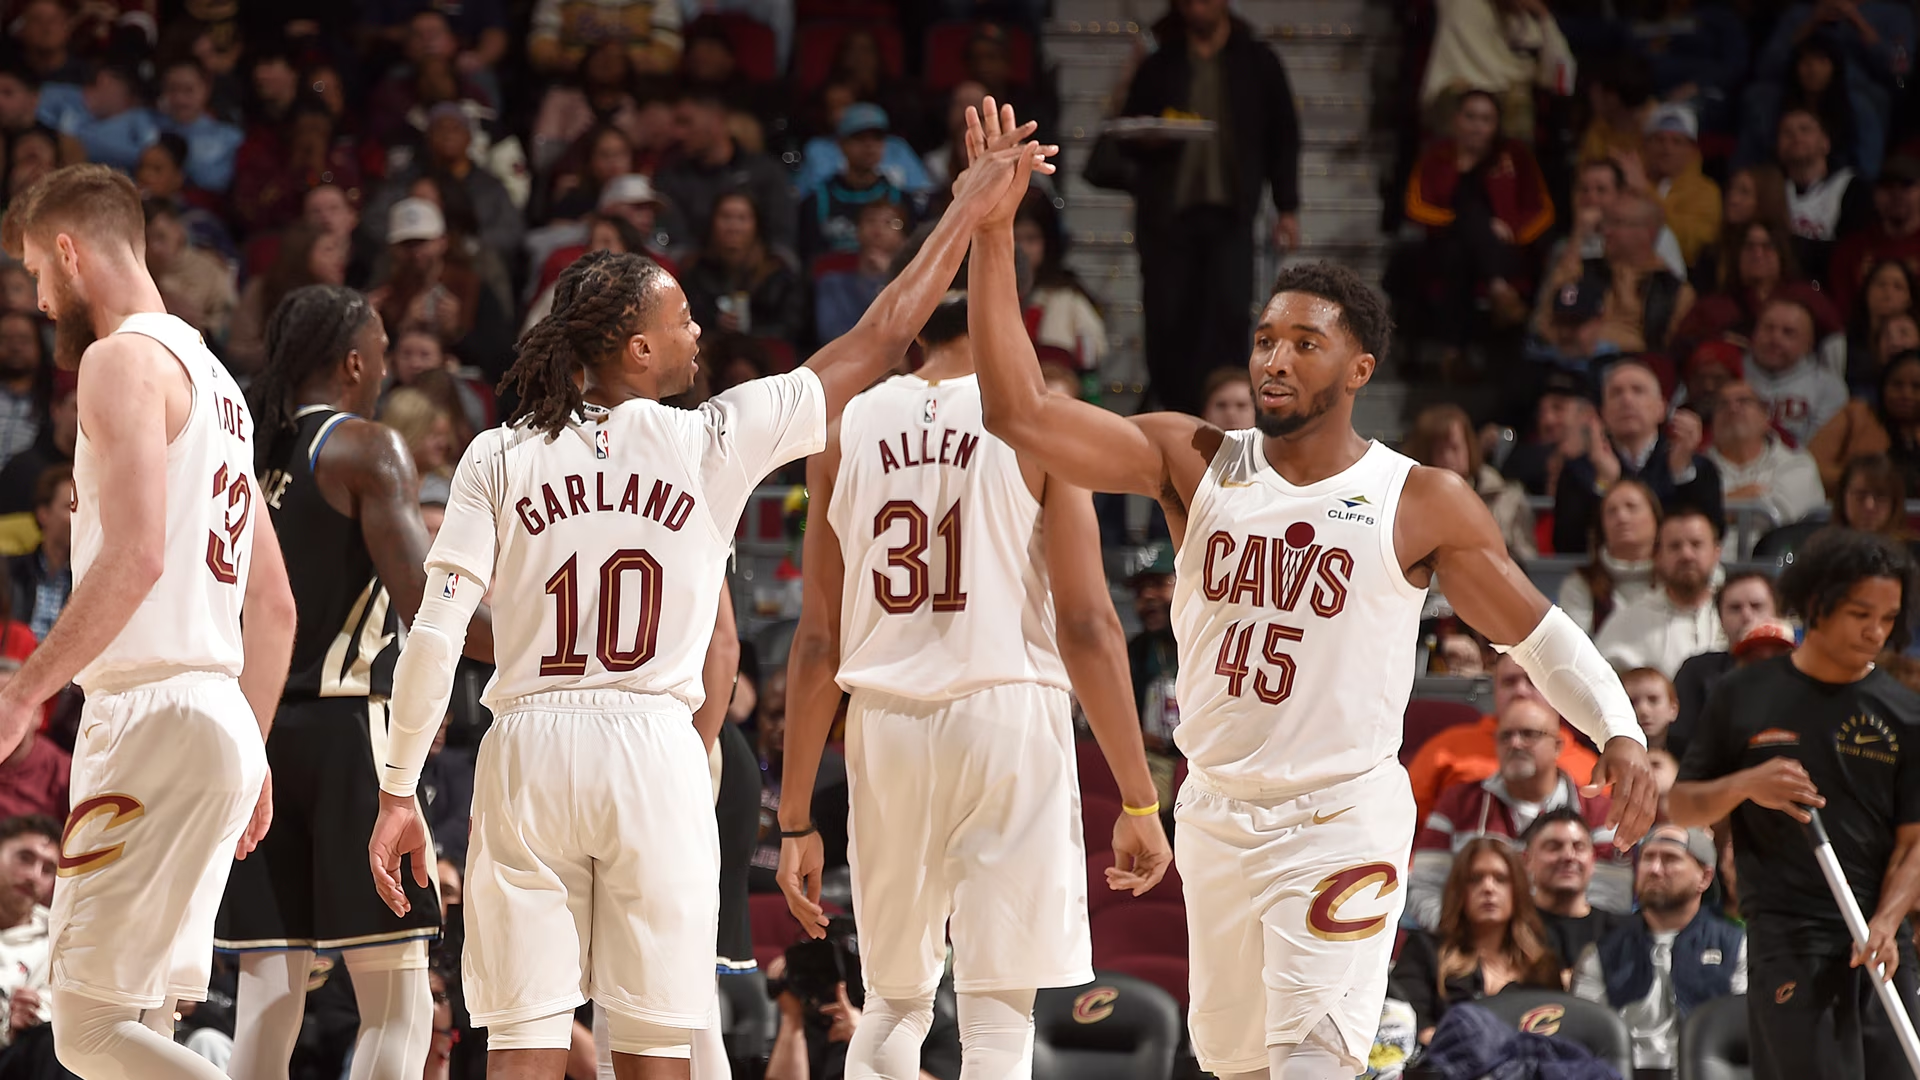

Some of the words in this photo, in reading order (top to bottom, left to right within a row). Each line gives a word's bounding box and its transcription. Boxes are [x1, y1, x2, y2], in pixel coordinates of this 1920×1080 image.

[879, 429, 979, 474] ALLEN
[515, 471, 695, 535] GARLAND
[1327, 509, 1375, 526] CLIFFS
[872, 498, 967, 614] 31
[1202, 524, 1354, 619] CAVS
[539, 548, 663, 676] 10
[1214, 620, 1305, 706] 45
[57, 793, 145, 878] C
[1306, 861, 1399, 941] C
